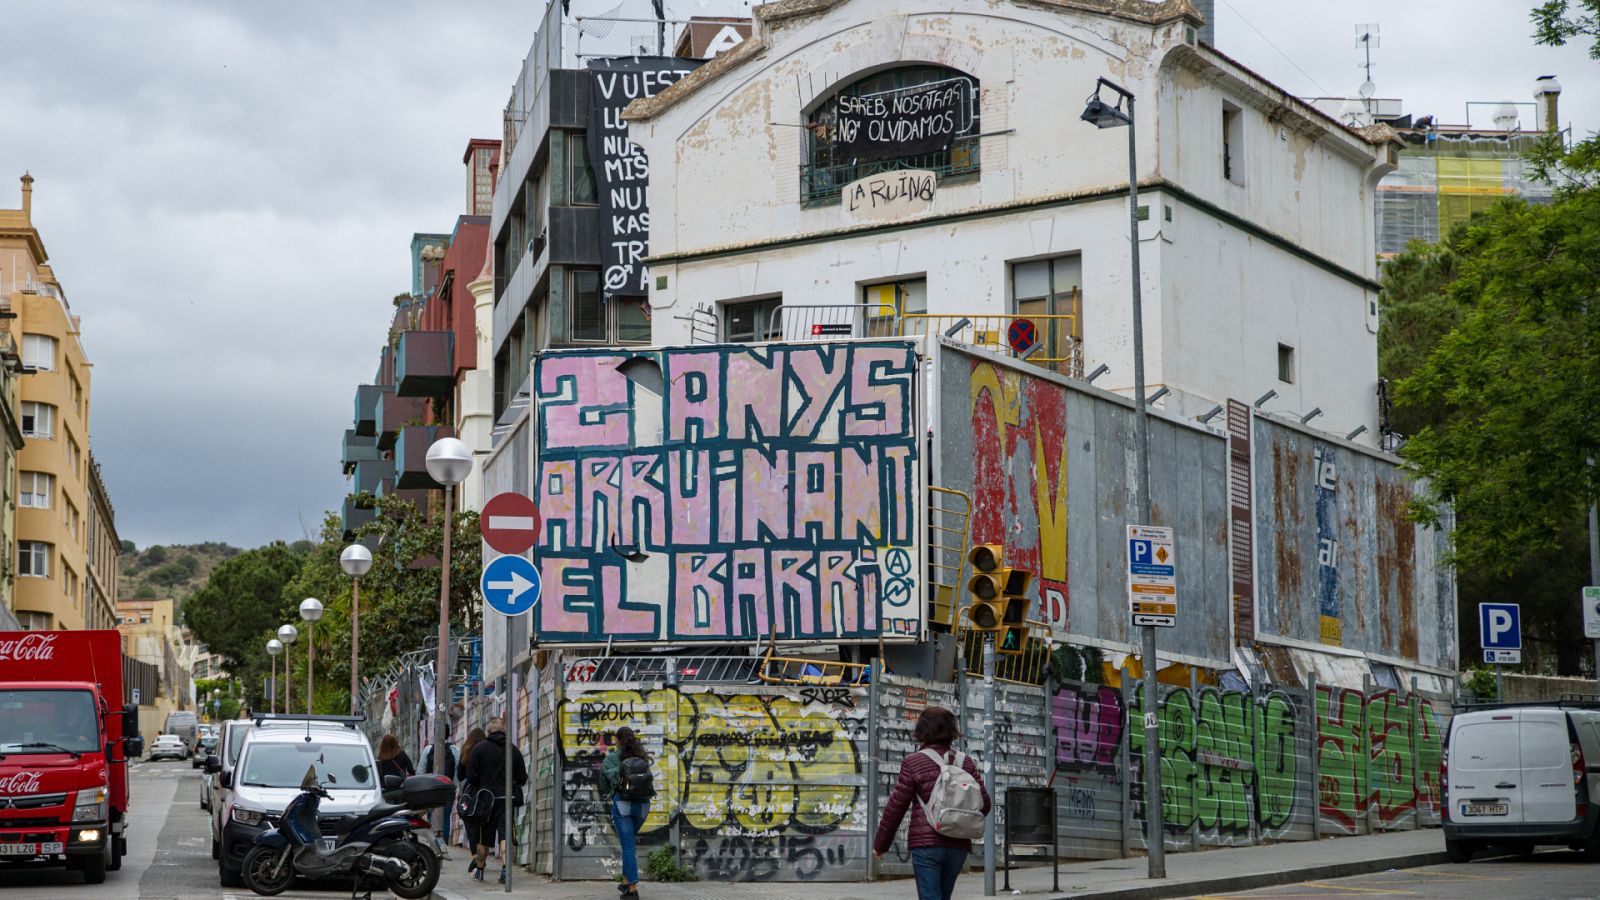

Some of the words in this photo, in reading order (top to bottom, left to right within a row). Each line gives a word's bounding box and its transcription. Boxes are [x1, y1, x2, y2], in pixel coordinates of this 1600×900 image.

[839, 96, 889, 118] SAREB,
[610, 186, 649, 211] NU
[850, 183, 866, 211] LA
[612, 240, 649, 264] TR
[538, 355, 636, 450] 2
[666, 345, 915, 446] ANYS
[1134, 541, 1147, 562] P
[538, 555, 660, 637] EL
[1488, 609, 1512, 643] P
[16, 845, 35, 854] LZG
